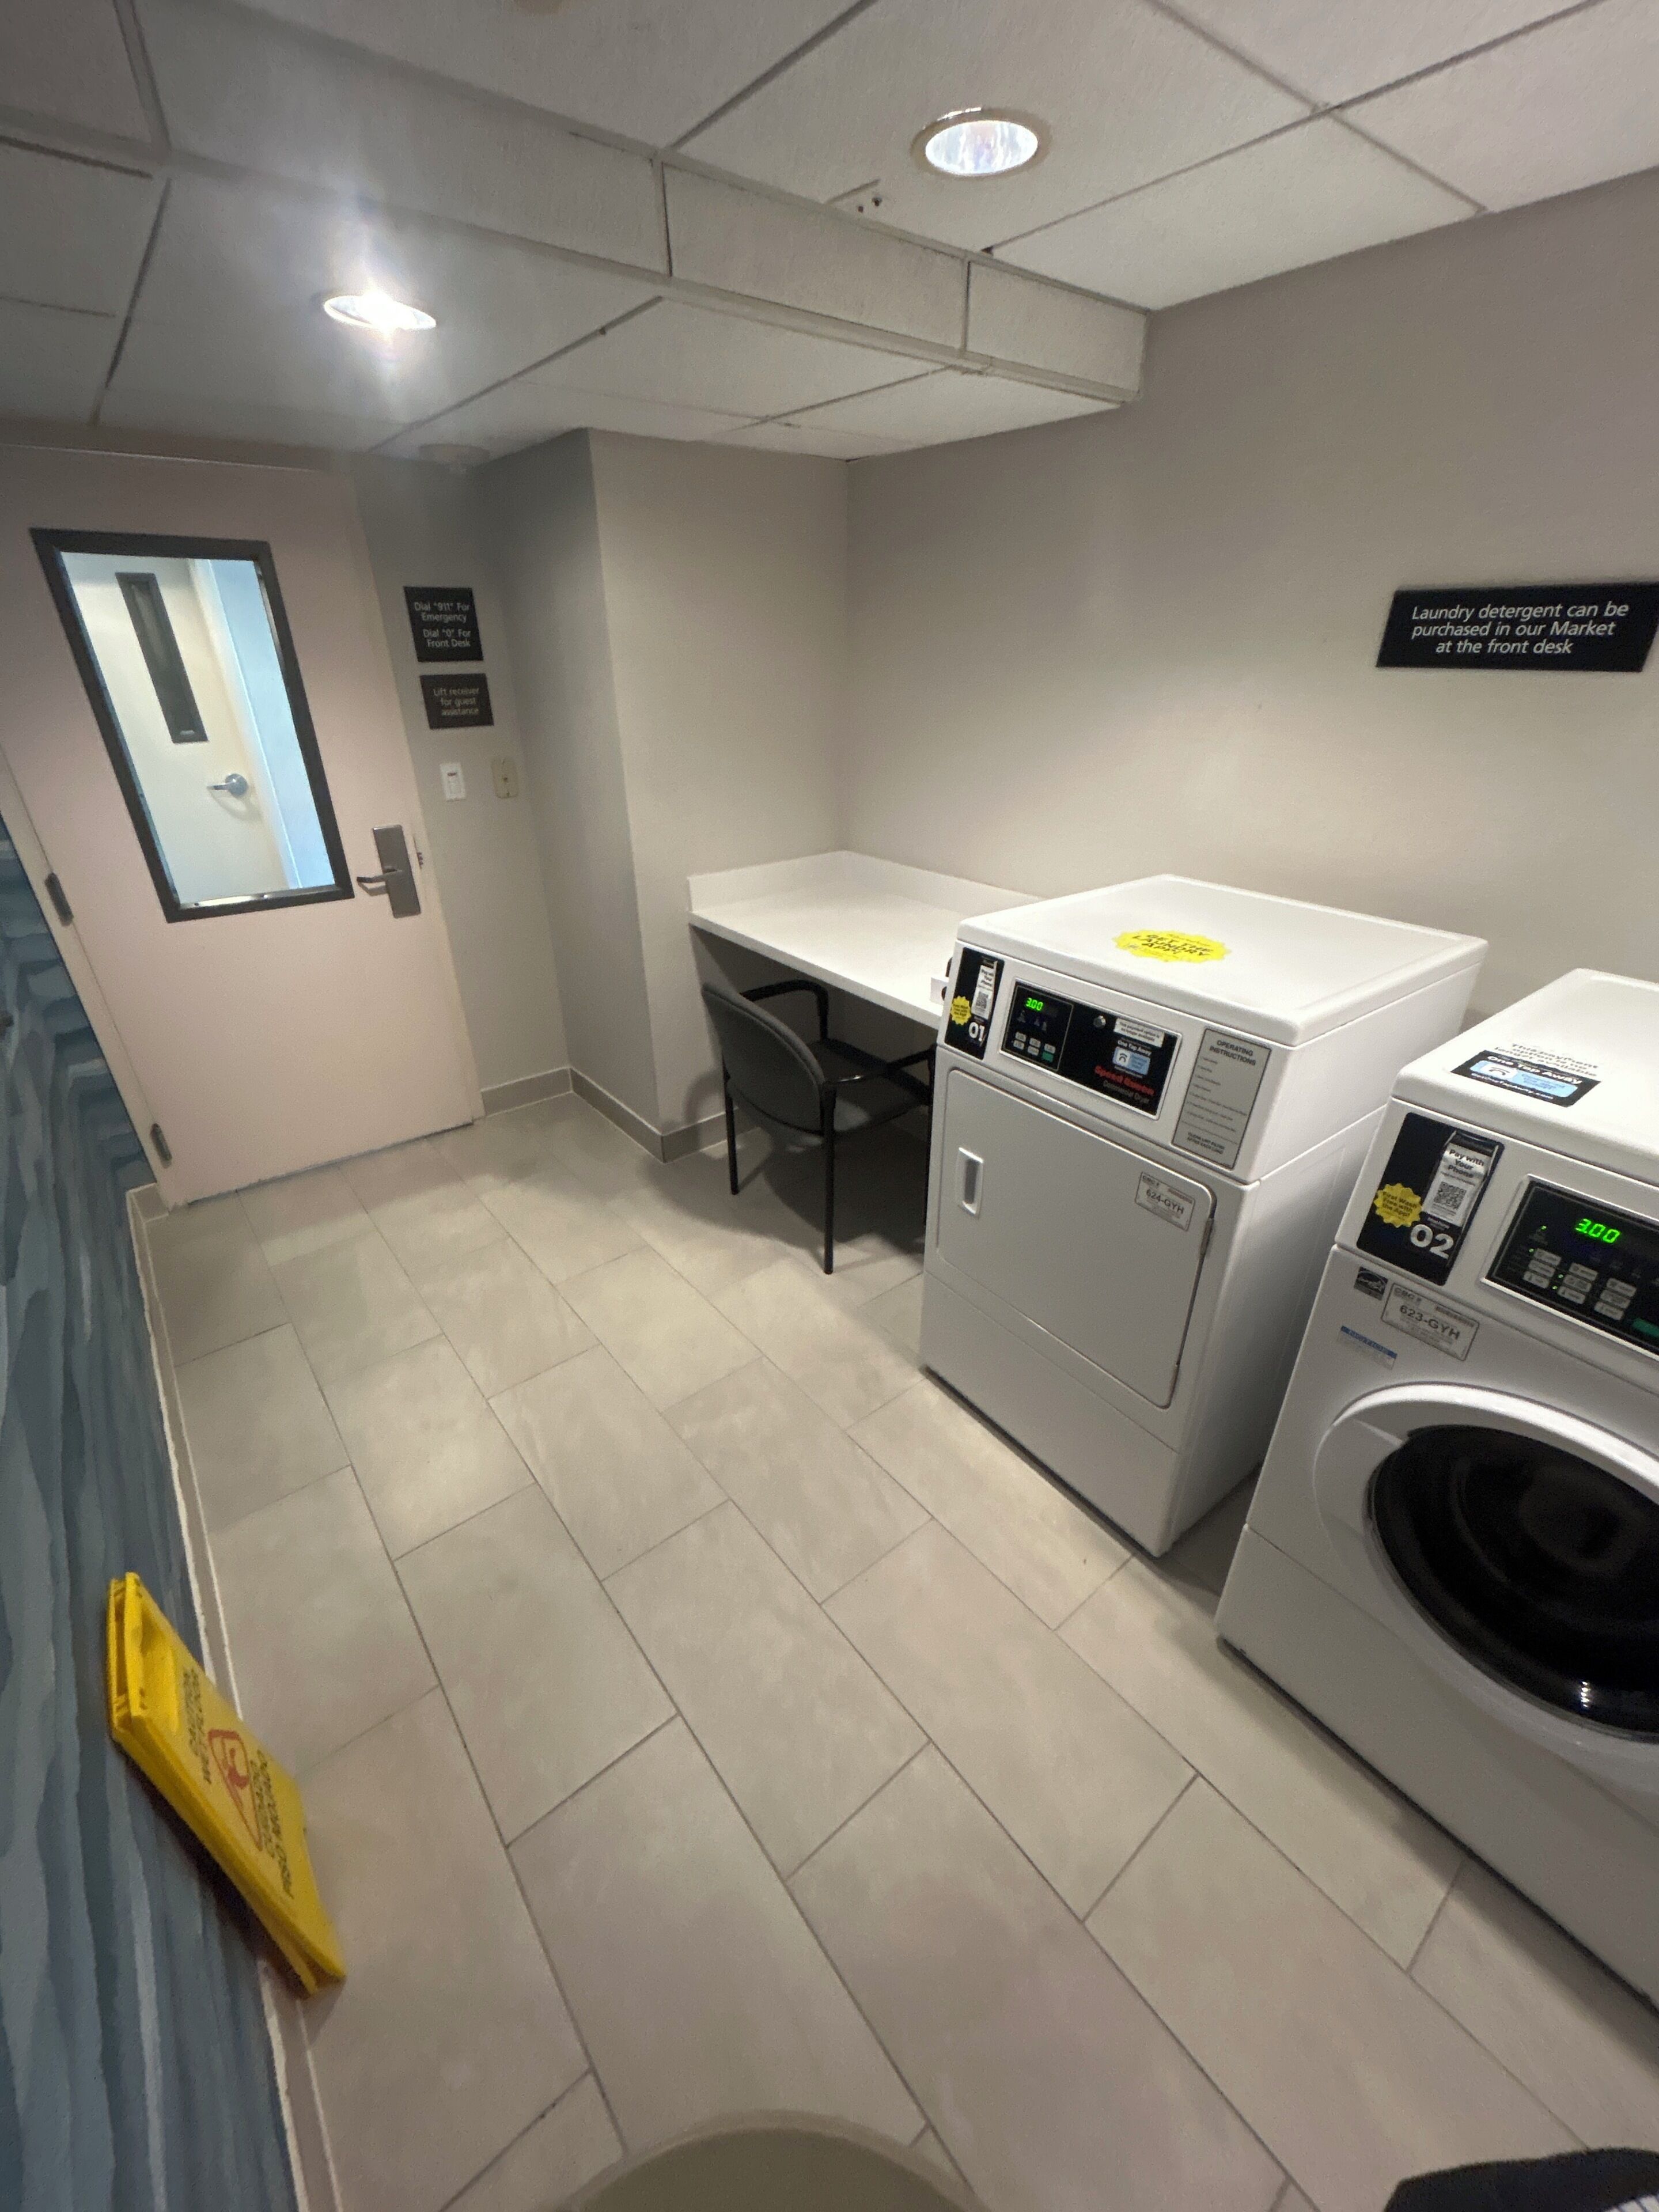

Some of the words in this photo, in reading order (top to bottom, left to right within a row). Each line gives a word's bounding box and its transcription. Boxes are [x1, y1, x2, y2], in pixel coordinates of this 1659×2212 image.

[414, 602, 431, 611] Dial
[457, 603, 470, 611] For
[1411, 605, 1475, 622] Laundry
[1479, 604, 1563, 622] detergent
[1567, 604, 1598, 617] can
[1603, 601, 1630, 617] be
[422, 613, 467, 623] Emergency
[423, 629, 439, 637] Dial
[458, 629, 471, 637] For
[1411, 622, 1491, 639] purchased
[1495, 622, 1510, 636] in
[1515, 623, 1546, 636] our
[1550, 620, 1616, 636] Market
[427, 639, 450, 647] Front
[452, 639, 471, 647] Desk
[1436, 641, 1452, 653] at
[1457, 639, 1482, 653] the
[1487, 639, 1531, 654] front
[1533, 639, 1573, 654] desk
[433, 687, 448, 696] Lift
[441, 698, 452, 706] for
[454, 698, 476, 707] guest
[442, 707, 479, 716] assistance
[968, 1021, 986, 1041] 01
[1210, 1046, 1256, 1066] INSTRUCTIONS
[1216, 1040, 1253, 1057] OPERATING
[1512, 1043, 1537, 1052] This
[1539, 1051, 1599, 1069] payment
[1487, 1055, 1514, 1065] One
[1517, 1063, 1540, 1073] Tap
[1542, 1070, 1583, 1084] Away
[1537, 1059, 1597, 1077] available
[1449, 1148, 1467, 1160] Pay
[1465, 1155, 1485, 1166] with
[1455, 1160, 1474, 1171] Your
[1448, 1165, 1474, 1179] Phone
[1146, 1189, 1184, 1214] 624-GYH
[1574, 1218, 1621, 1244] 3.00
[1410, 1224, 1454, 1259] 02
[1399, 1304, 1461, 1340] 623-GYH
